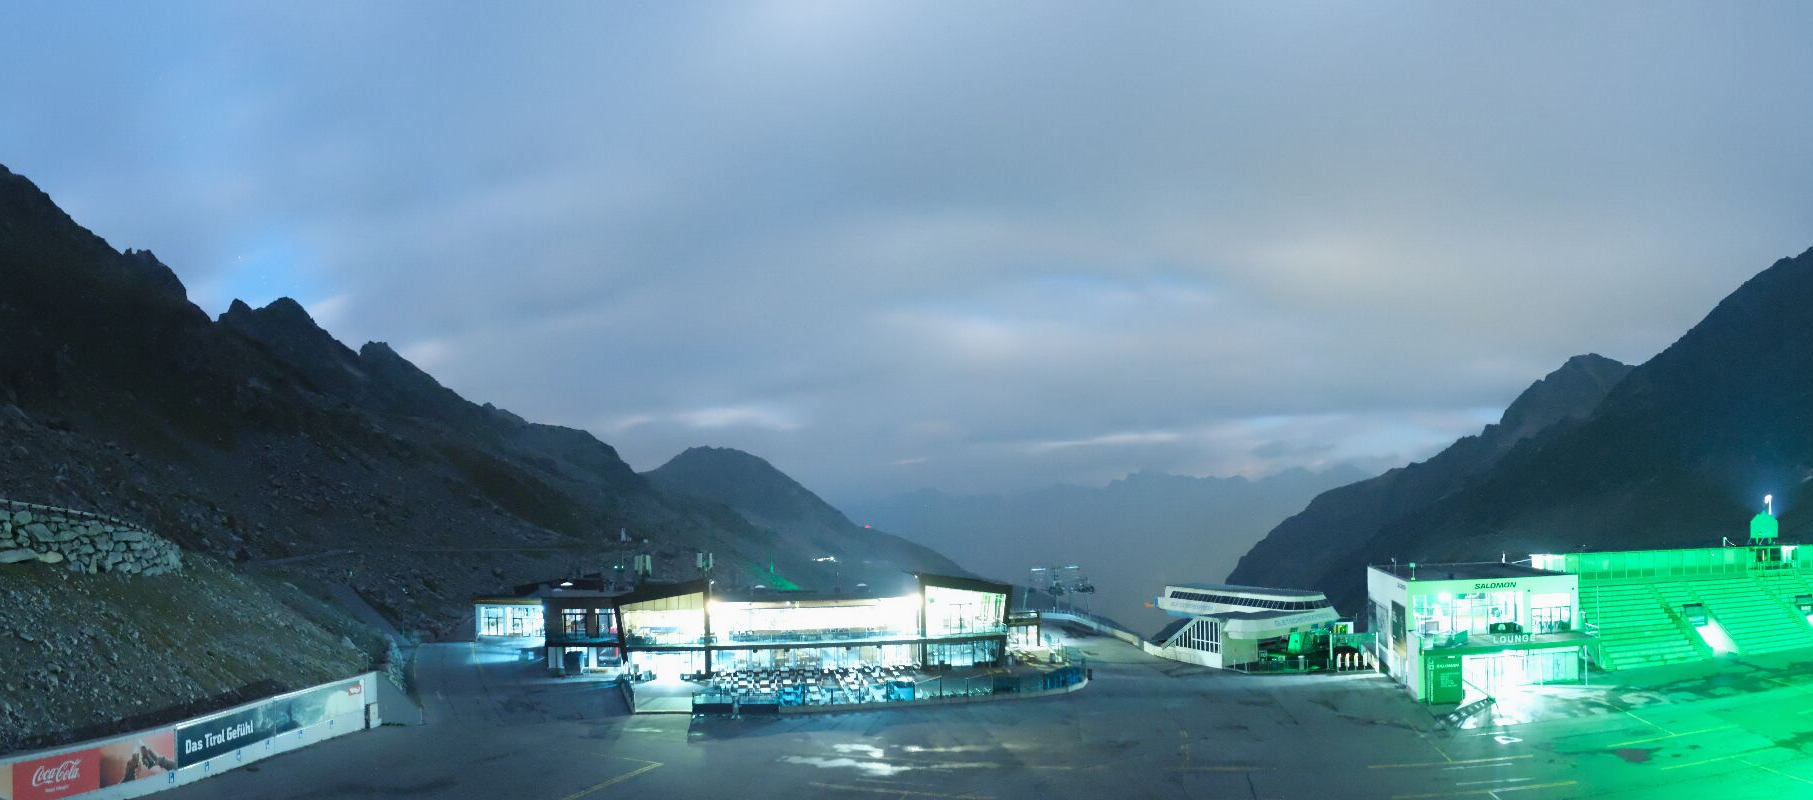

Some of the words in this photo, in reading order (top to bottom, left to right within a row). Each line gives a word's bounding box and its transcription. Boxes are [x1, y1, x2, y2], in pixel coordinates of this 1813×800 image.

[1474, 581, 1517, 590] SALOMON
[1493, 634, 1536, 644] LOUNGE
[185, 738, 203, 755] Das
[204, 728, 226, 749] Tirol
[226, 720, 254, 741] Gefühl
